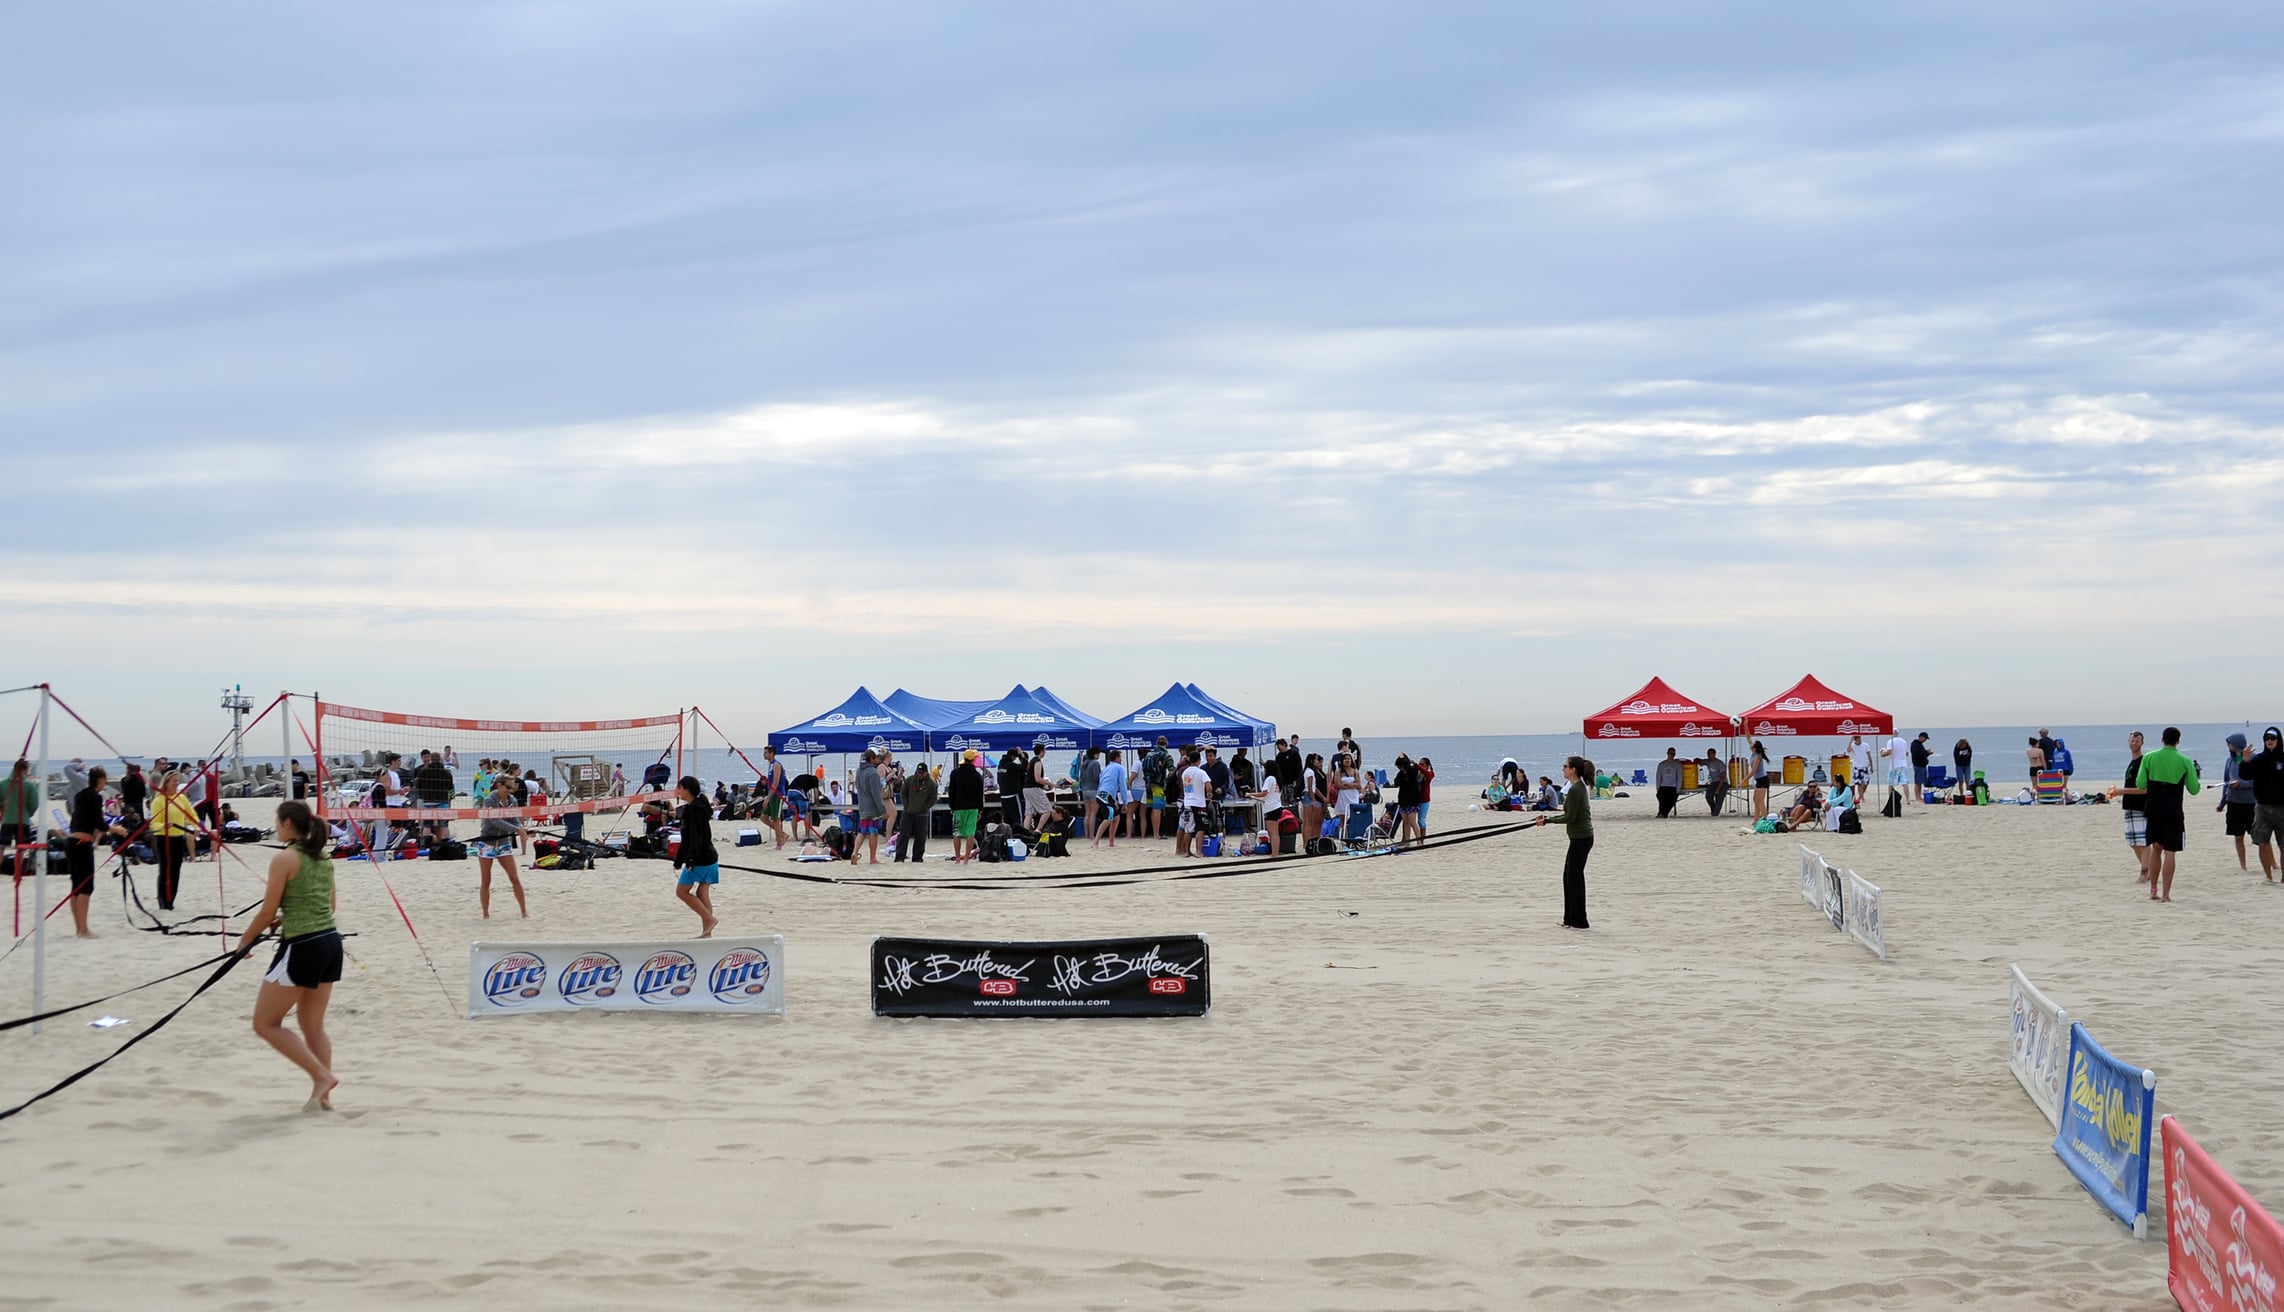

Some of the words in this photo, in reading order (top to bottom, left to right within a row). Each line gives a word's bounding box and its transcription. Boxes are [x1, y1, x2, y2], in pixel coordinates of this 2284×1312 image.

[502, 957, 536, 970] Miller
[577, 957, 610, 970] Miller
[654, 955, 685, 969] Miller
[728, 953, 760, 967] Miller
[878, 955, 925, 997] Hot
[922, 950, 1035, 982] Buttered
[1091, 944, 1203, 982] Buttered
[488, 965, 546, 996] Lite
[563, 965, 620, 996] Lite
[639, 963, 695, 995] Lite
[712, 961, 768, 993] Lite
[973, 999, 1110, 1007] www.hotbutteredusa.com
